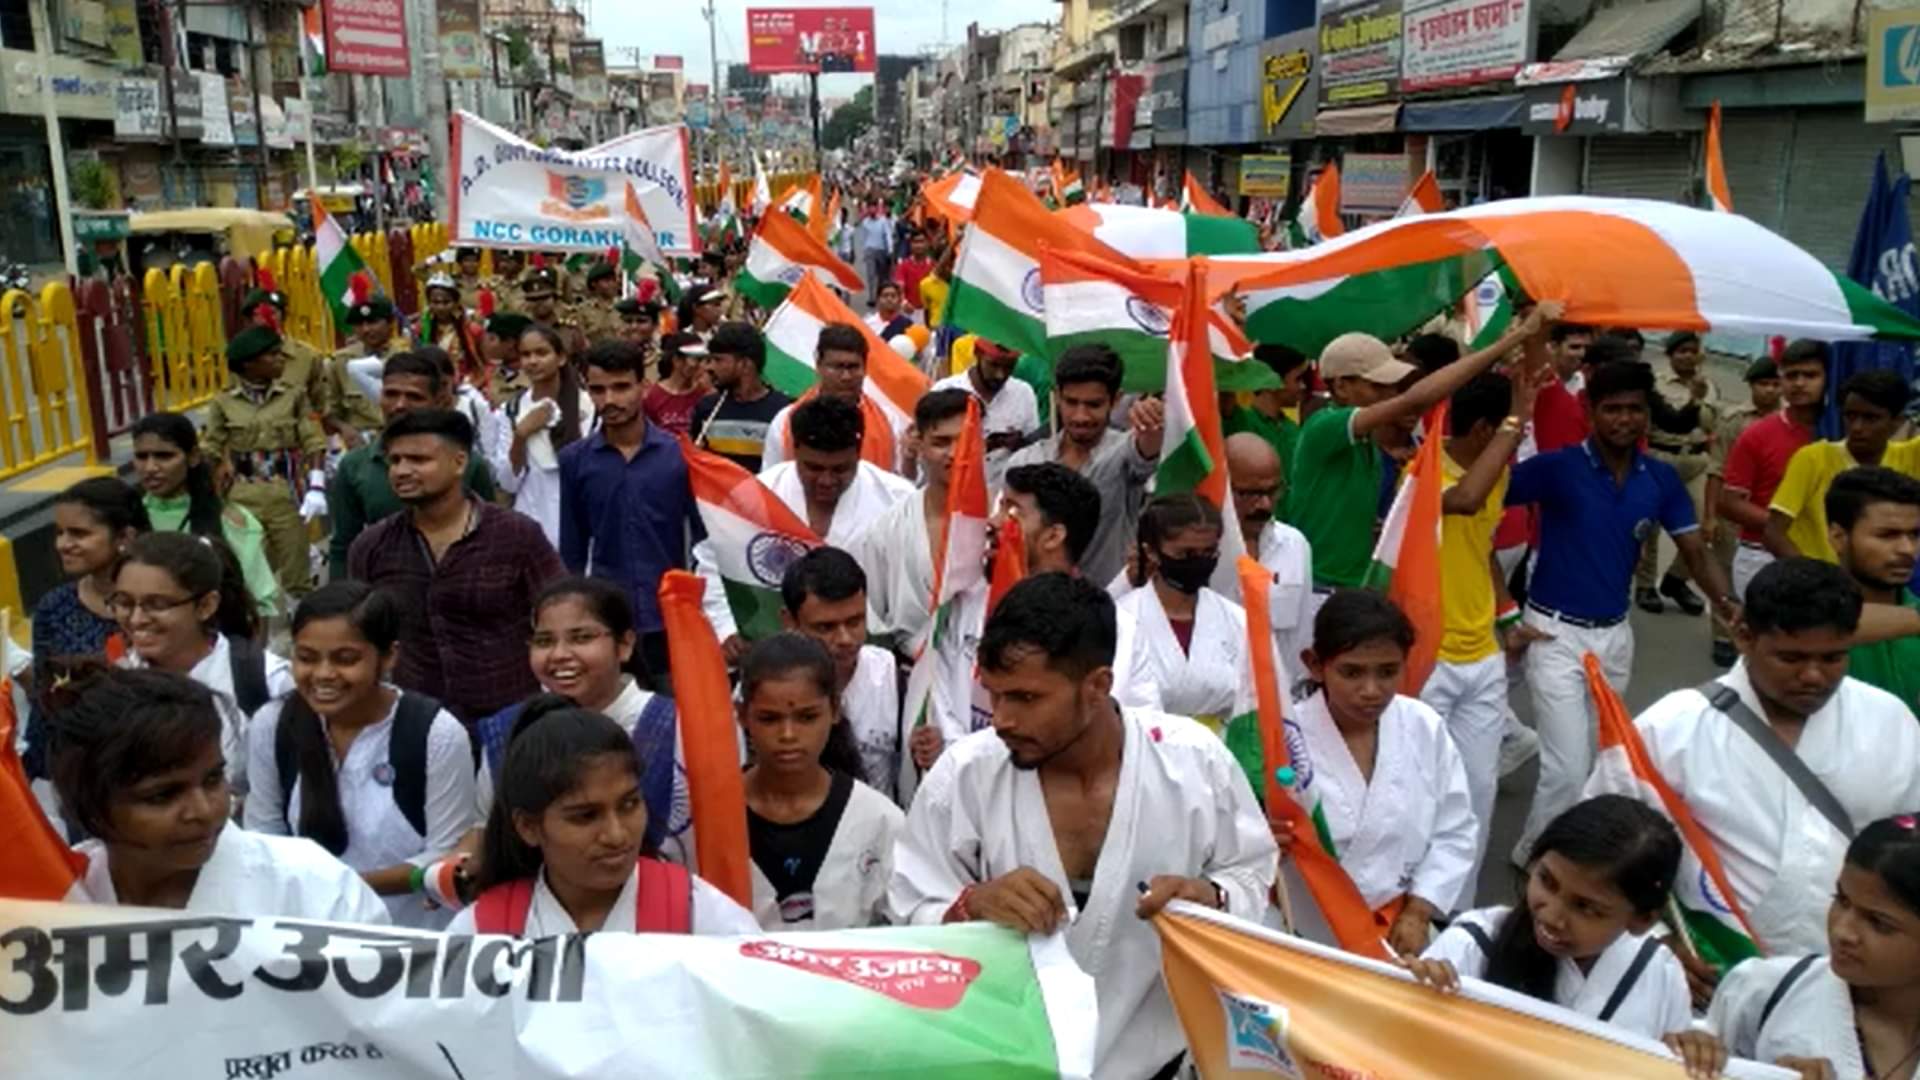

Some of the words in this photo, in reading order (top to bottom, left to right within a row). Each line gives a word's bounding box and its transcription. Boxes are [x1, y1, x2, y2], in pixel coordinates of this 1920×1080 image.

[474, 220, 522, 241] NCC
[530, 226, 675, 247] GORAKHR
[0, 916, 254, 1015] अमर
[254, 921, 585, 1002] उजाला
